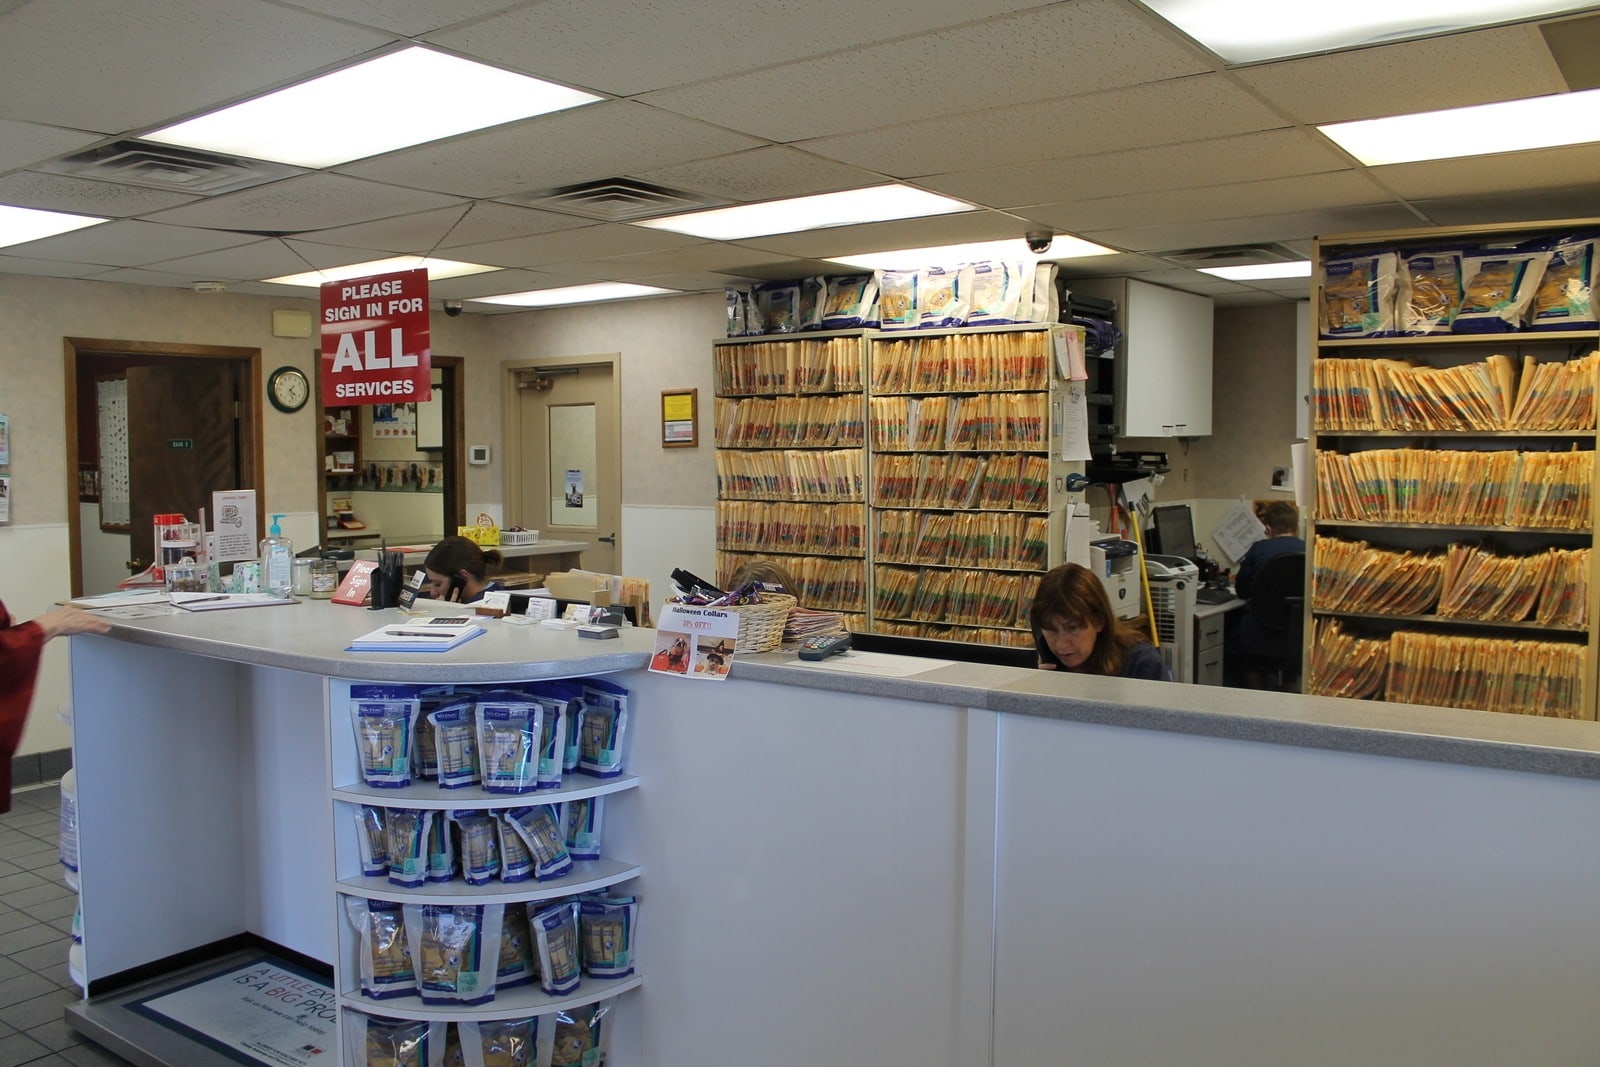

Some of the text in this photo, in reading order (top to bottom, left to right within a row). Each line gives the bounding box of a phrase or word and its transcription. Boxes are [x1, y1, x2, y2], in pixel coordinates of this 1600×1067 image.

[342, 280, 403, 301] PLEASE
[325, 298, 423, 322] SIGN IN FOR
[331, 327, 418, 373] ALL
[335, 379, 414, 398] SERVICES
[349, 575, 367, 588] Sign
[346, 587, 356, 598] In
[672, 606, 728, 618] Halloween Collars
[232, 974, 258, 985] IS
[248, 982, 269, 991] A
[264, 986, 303, 1004] BIG
[255, 968, 271, 976] A
[268, 972, 313, 992] LITTLE
